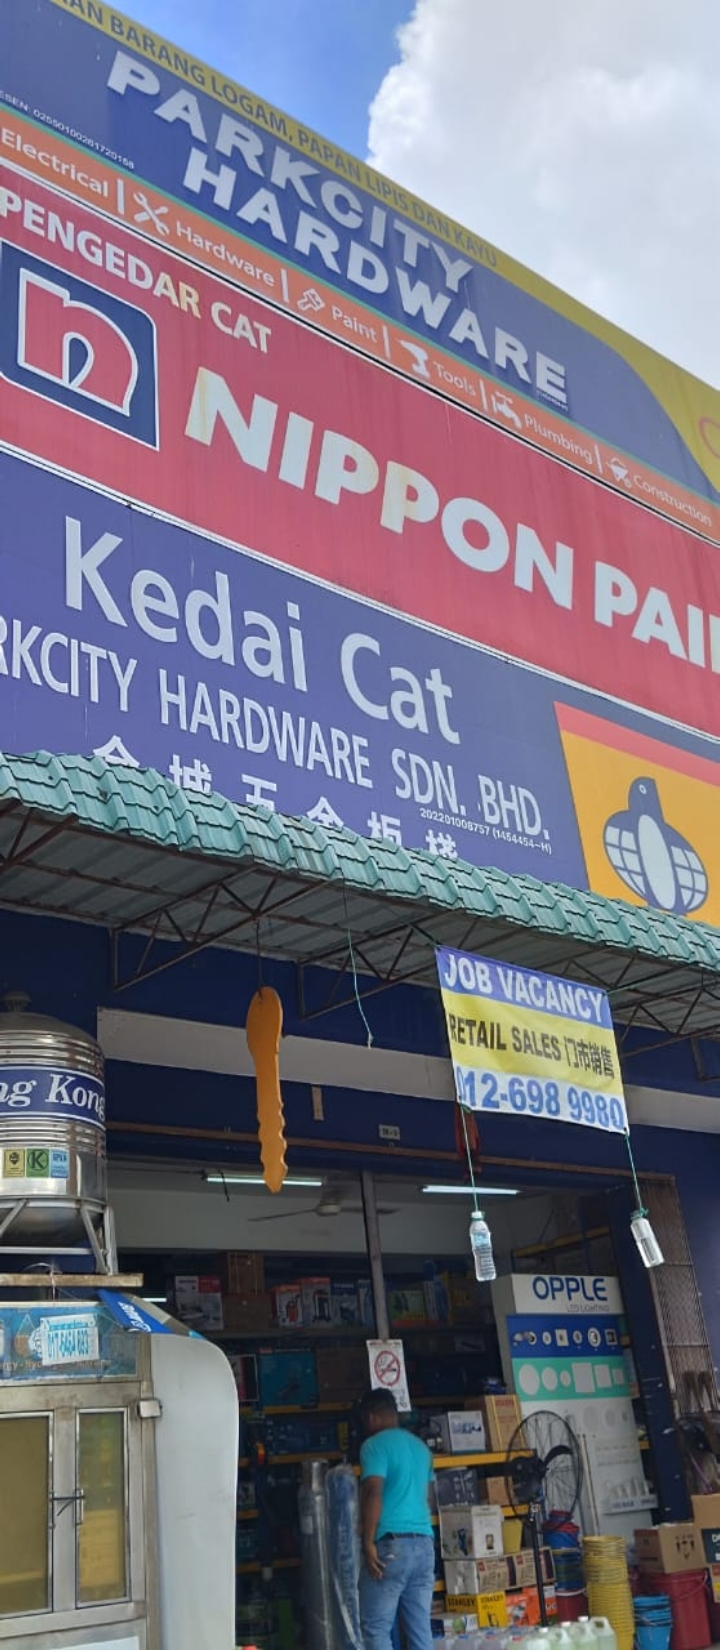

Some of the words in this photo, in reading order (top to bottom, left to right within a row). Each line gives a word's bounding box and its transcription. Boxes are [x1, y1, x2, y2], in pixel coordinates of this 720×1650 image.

[63, 0, 103, 25] AN
[110, 15, 206, 86] BARANG
[211, 74, 293, 142] LOGAM,
[298, 128, 361, 182] PAPAN
[365, 169, 409, 213] LIPIS
[411, 200, 452, 238] DAN
[453, 223, 498, 267] KAYU
[106, 50, 473, 294] PARKCITY
[0, 186, 202, 319] PENGEDAR
[211, 301, 272, 354] CAT
[2, 127, 108, 198] Electrical
[176, 221, 275, 287] Hardware
[332, 305, 378, 344] Paint
[433, 361, 476, 397] Tools
[524, 414, 593, 467] Plumbing
[633, 475, 714, 528] Construction
[183, 147, 567, 404] HARDWARE
[184, 366, 574, 611] NIPPON
[594, 560, 720, 675] PAI
[65, 515, 308, 692] Kedai
[340, 632, 461, 745] Cat
[159, 668, 373, 789] HARDWARE
[391, 748, 467, 816] SDN.
[478, 774, 550, 839] BHD.
[444, 954, 493, 994] JOB
[497, 966, 602, 1023] VACANCY
[449, 1013, 507, 1051] RETAIL
[511, 1026, 562, 1062] SALES
[456, 1066, 561, 1117] 012-698
[567, 1086, 625, 1131] 9980
[532, 1276, 608, 1301] OPPLE
